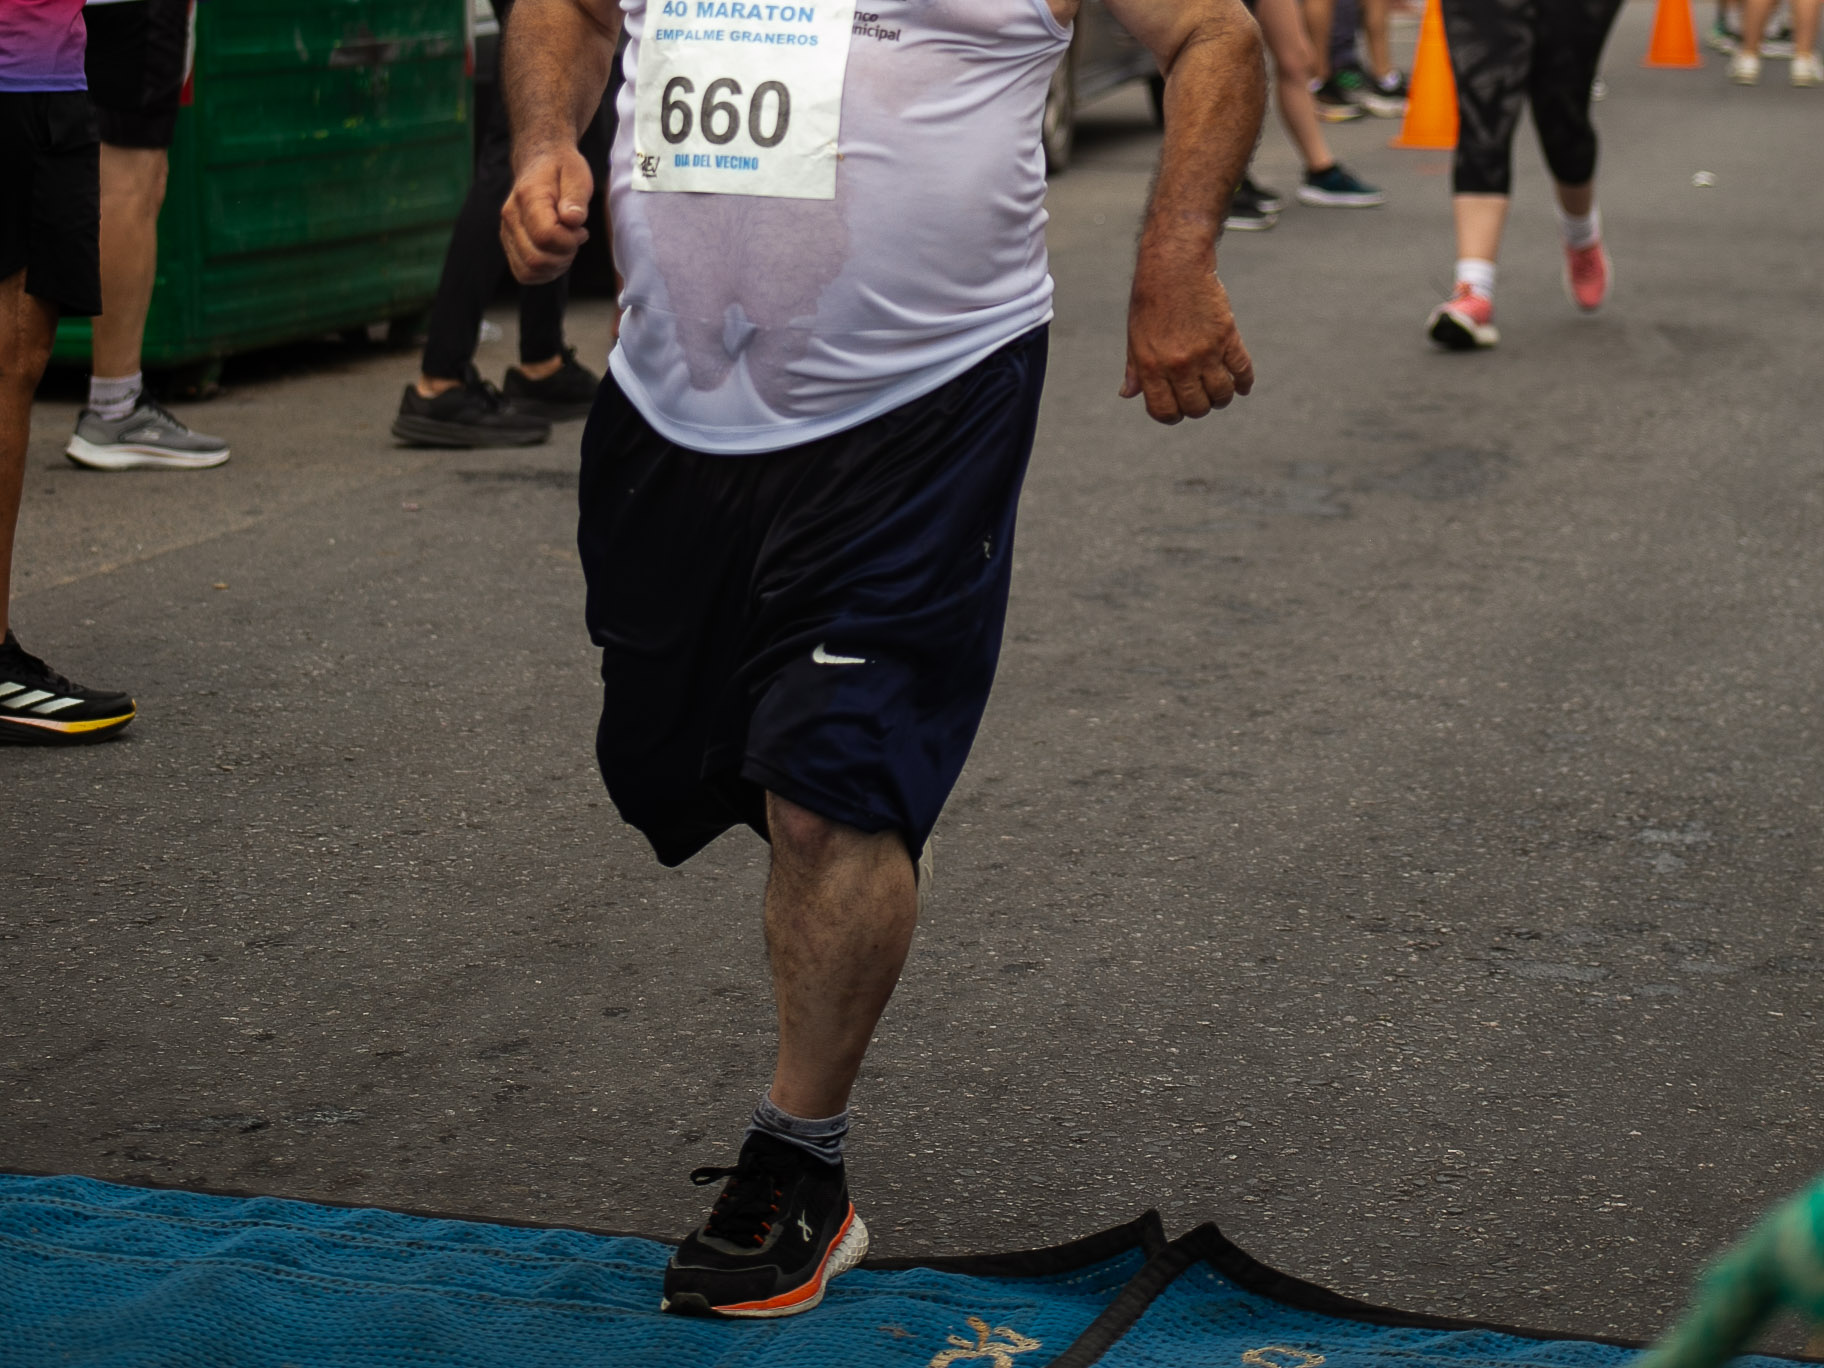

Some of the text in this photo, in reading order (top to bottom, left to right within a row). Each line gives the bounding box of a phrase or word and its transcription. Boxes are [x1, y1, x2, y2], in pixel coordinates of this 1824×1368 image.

[662, 0, 815, 23] 40 MARATON
[655, 28, 819, 47] EMPALME GRANEROS
[660, 75, 791, 149] 660
[674, 153, 760, 170] DIA DEL VECINO
